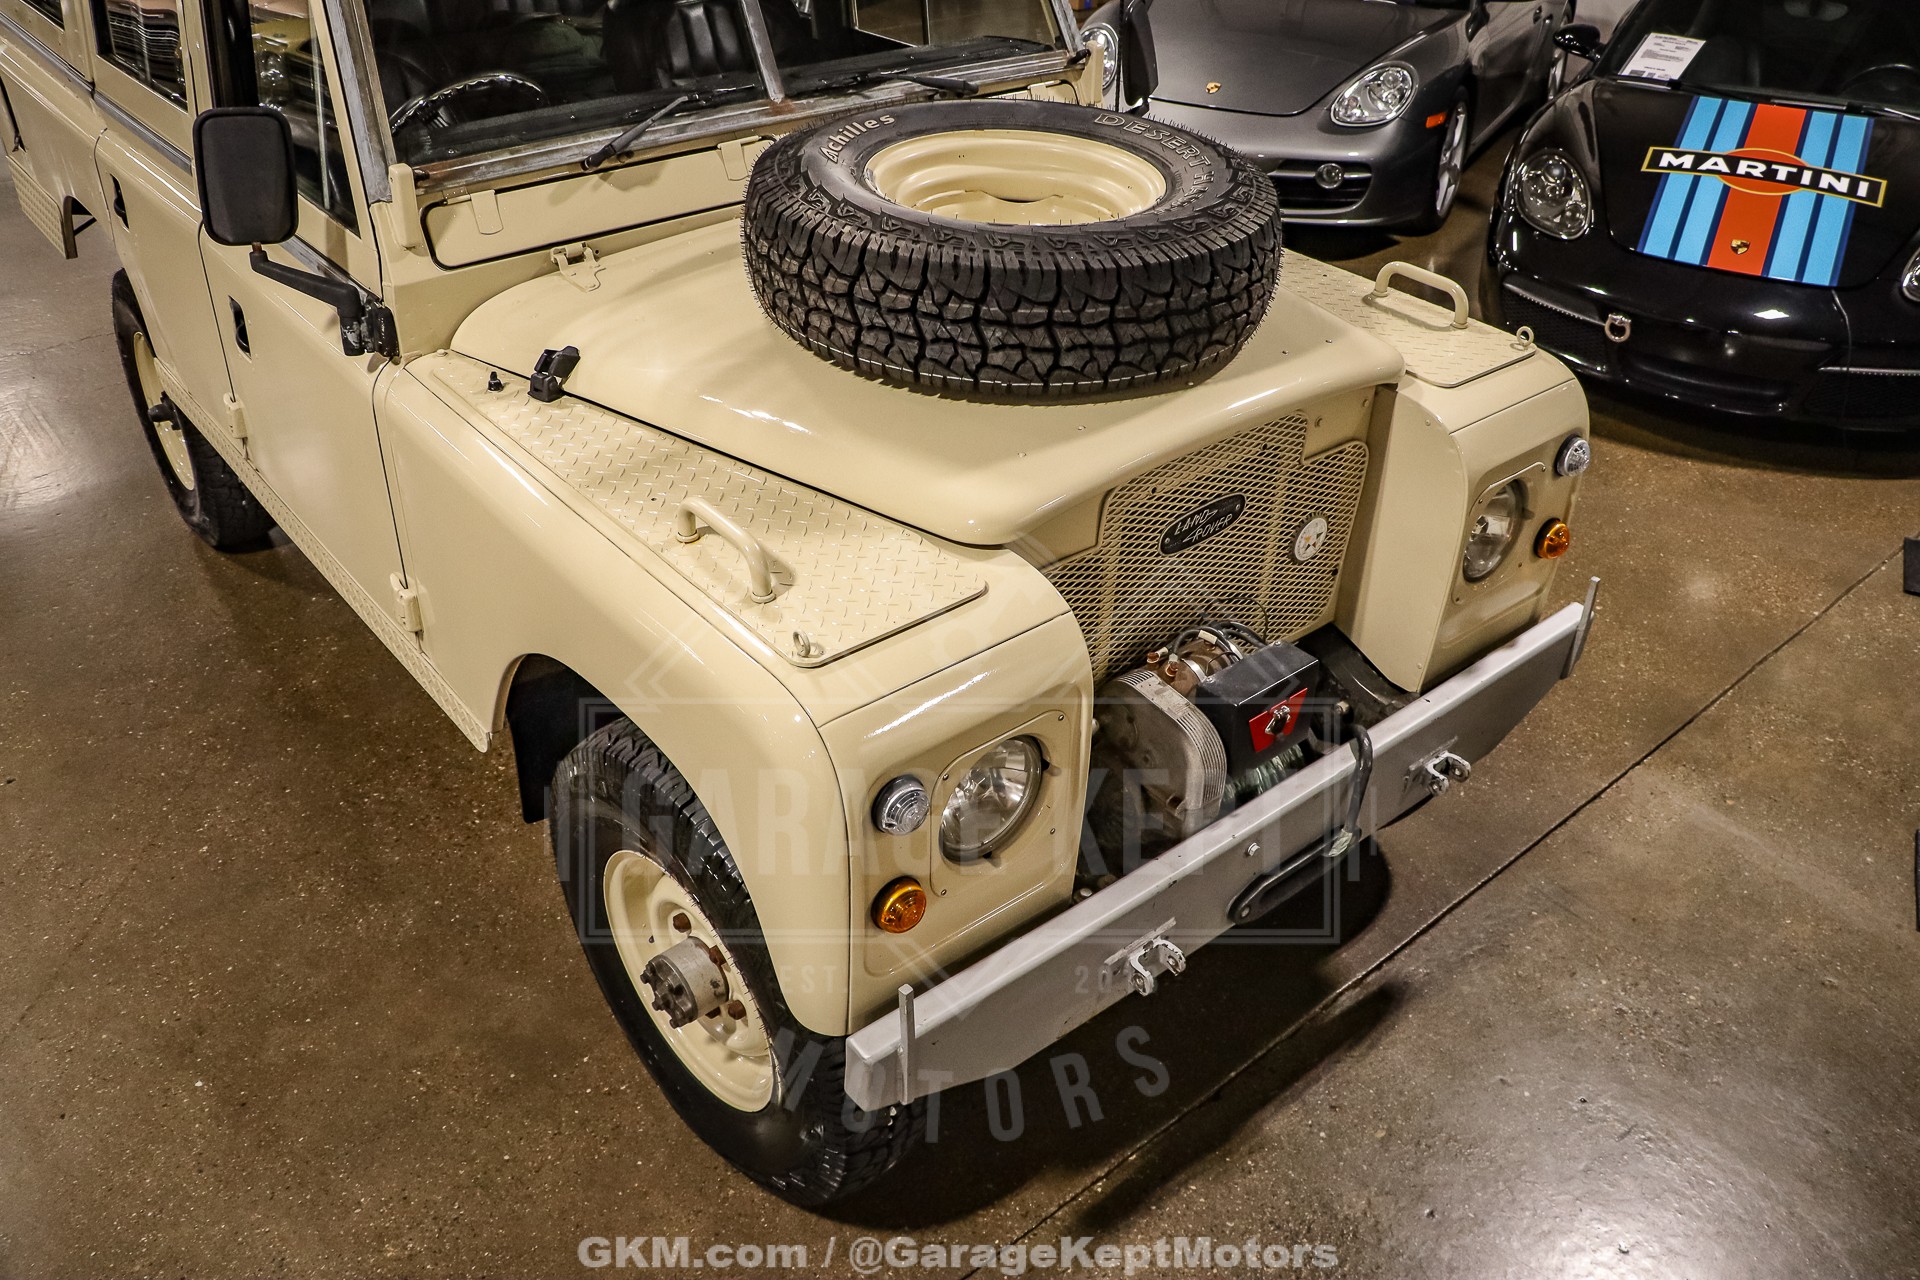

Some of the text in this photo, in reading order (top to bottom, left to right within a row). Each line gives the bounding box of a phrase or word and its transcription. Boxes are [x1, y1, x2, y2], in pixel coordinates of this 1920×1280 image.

[819, 114, 896, 164] Achilles
[1094, 112, 1212, 168] DESERT
[1658, 152, 1870, 199] MARTINI
[1174, 508, 1211, 536] LAND
[1191, 513, 1233, 543] ROVER
